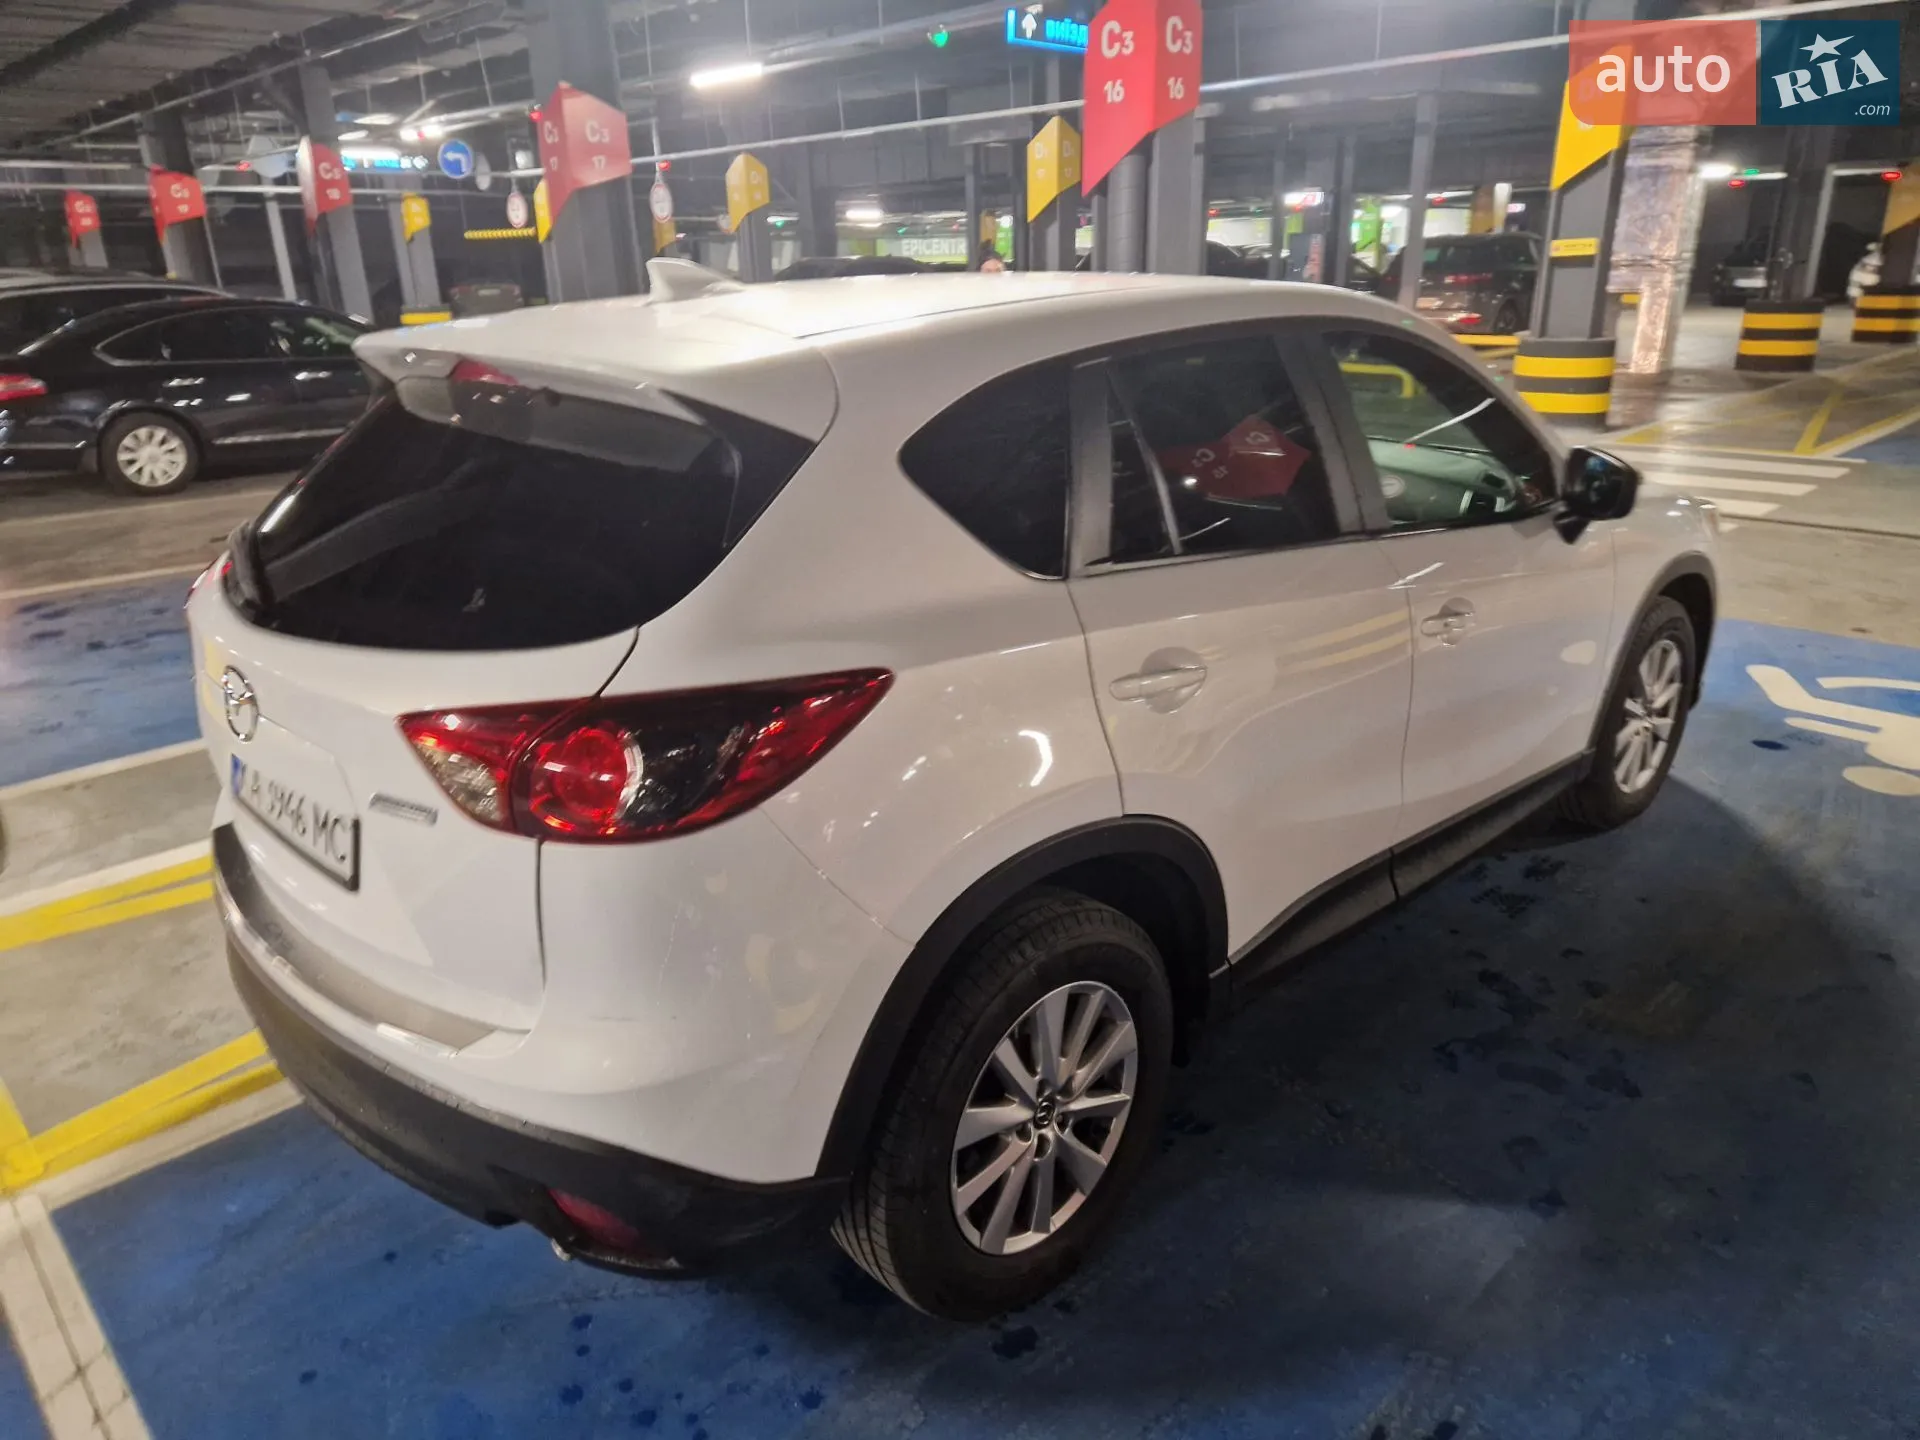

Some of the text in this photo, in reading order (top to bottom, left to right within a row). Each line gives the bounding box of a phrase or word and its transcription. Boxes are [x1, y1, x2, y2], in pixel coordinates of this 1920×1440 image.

[1101, 20, 1134, 59] C3
[1166, 16, 1193, 54] C3
[1104, 79, 1124, 104] 16
[1167, 76, 1184, 100] 16
[585, 120, 610, 143] C3
[592, 154, 606, 171] 17
